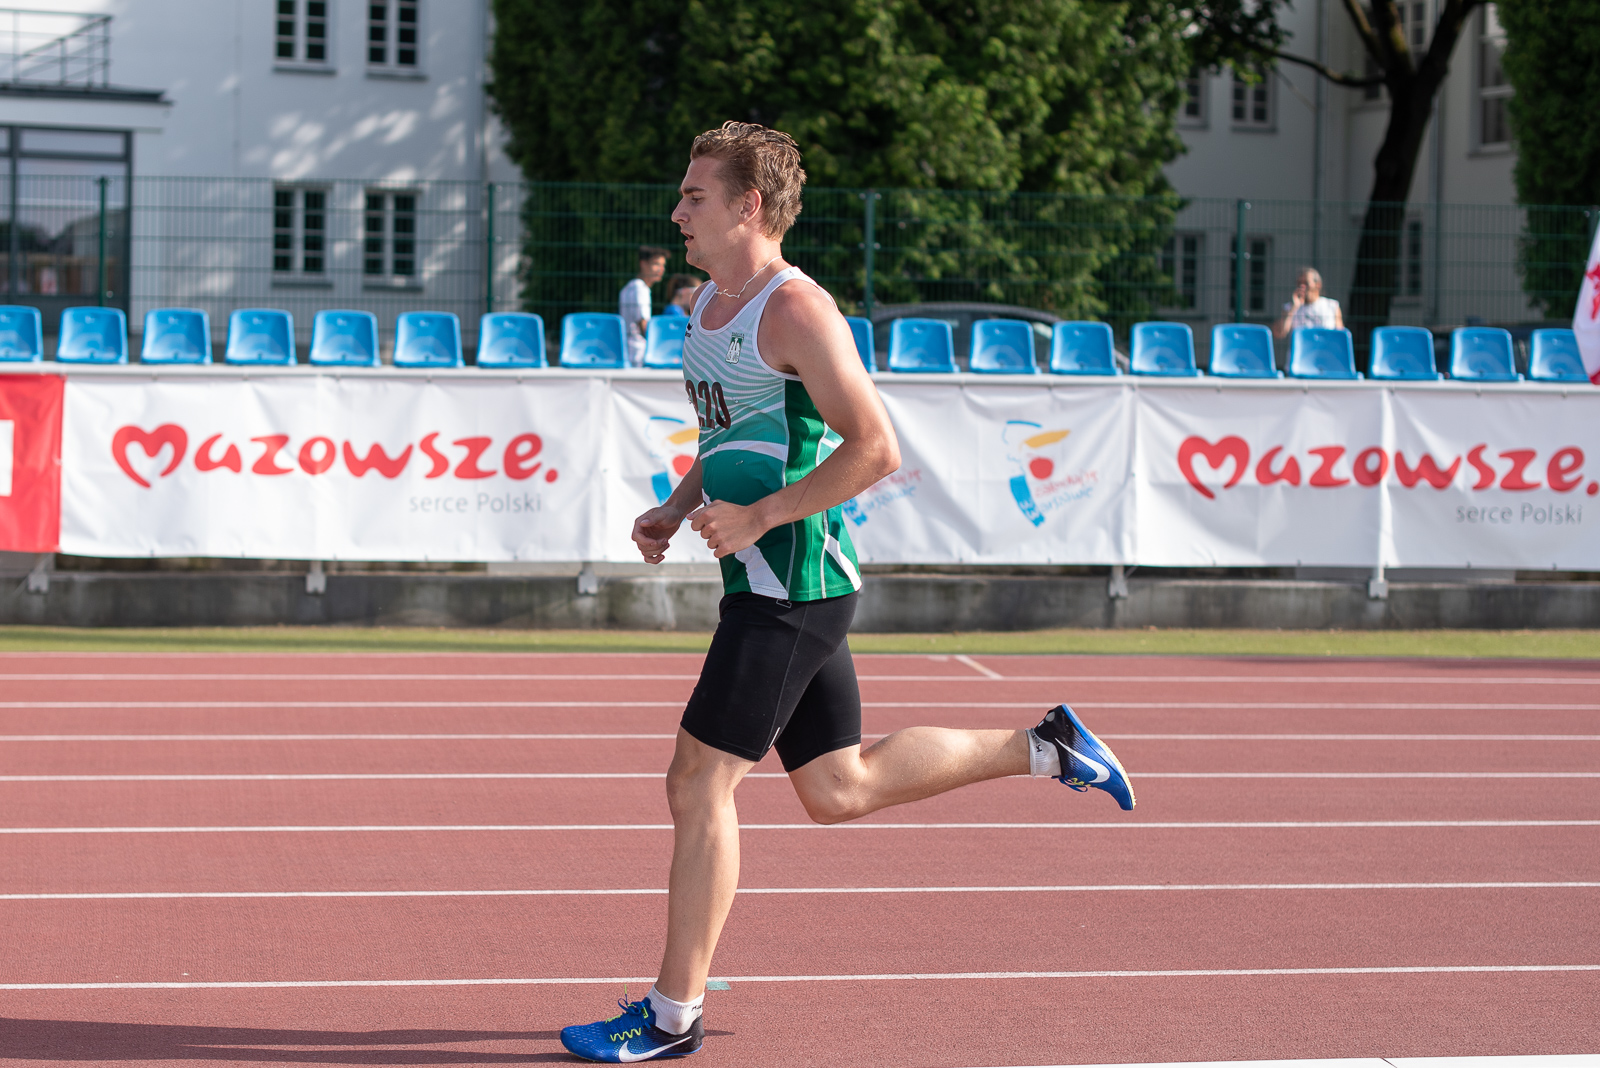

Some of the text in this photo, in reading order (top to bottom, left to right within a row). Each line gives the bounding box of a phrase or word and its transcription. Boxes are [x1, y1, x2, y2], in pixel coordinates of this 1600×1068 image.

[410, 492, 541, 513] serce Polski
[1456, 504, 1582, 525] serce Polski
